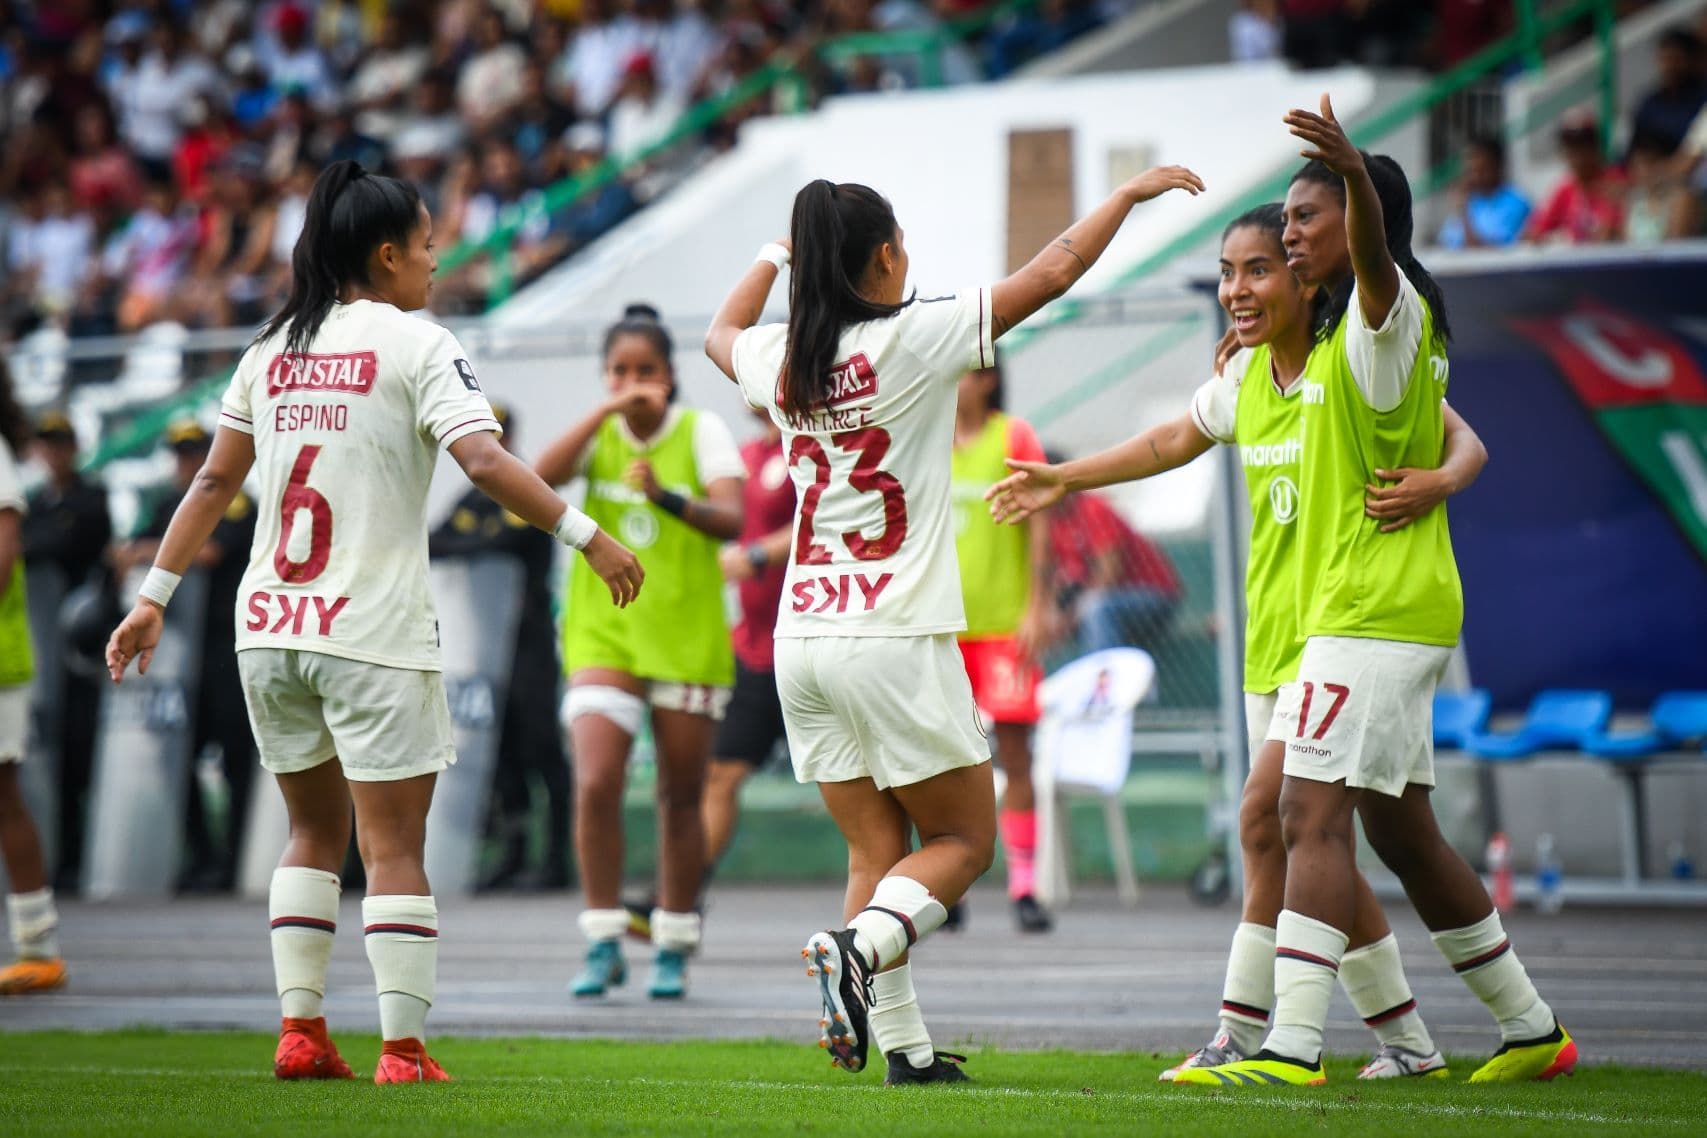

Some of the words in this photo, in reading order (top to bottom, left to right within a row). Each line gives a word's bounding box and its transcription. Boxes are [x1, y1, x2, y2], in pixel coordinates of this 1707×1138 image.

[272, 356, 367, 388] CRISTAL
[275, 404, 348, 432] ESPINO
[274, 444, 333, 584] 6
[789, 427, 908, 566] 23
[246, 591, 351, 637] SKY
[791, 573, 894, 613] SKY
[1295, 681, 1350, 741] 17
